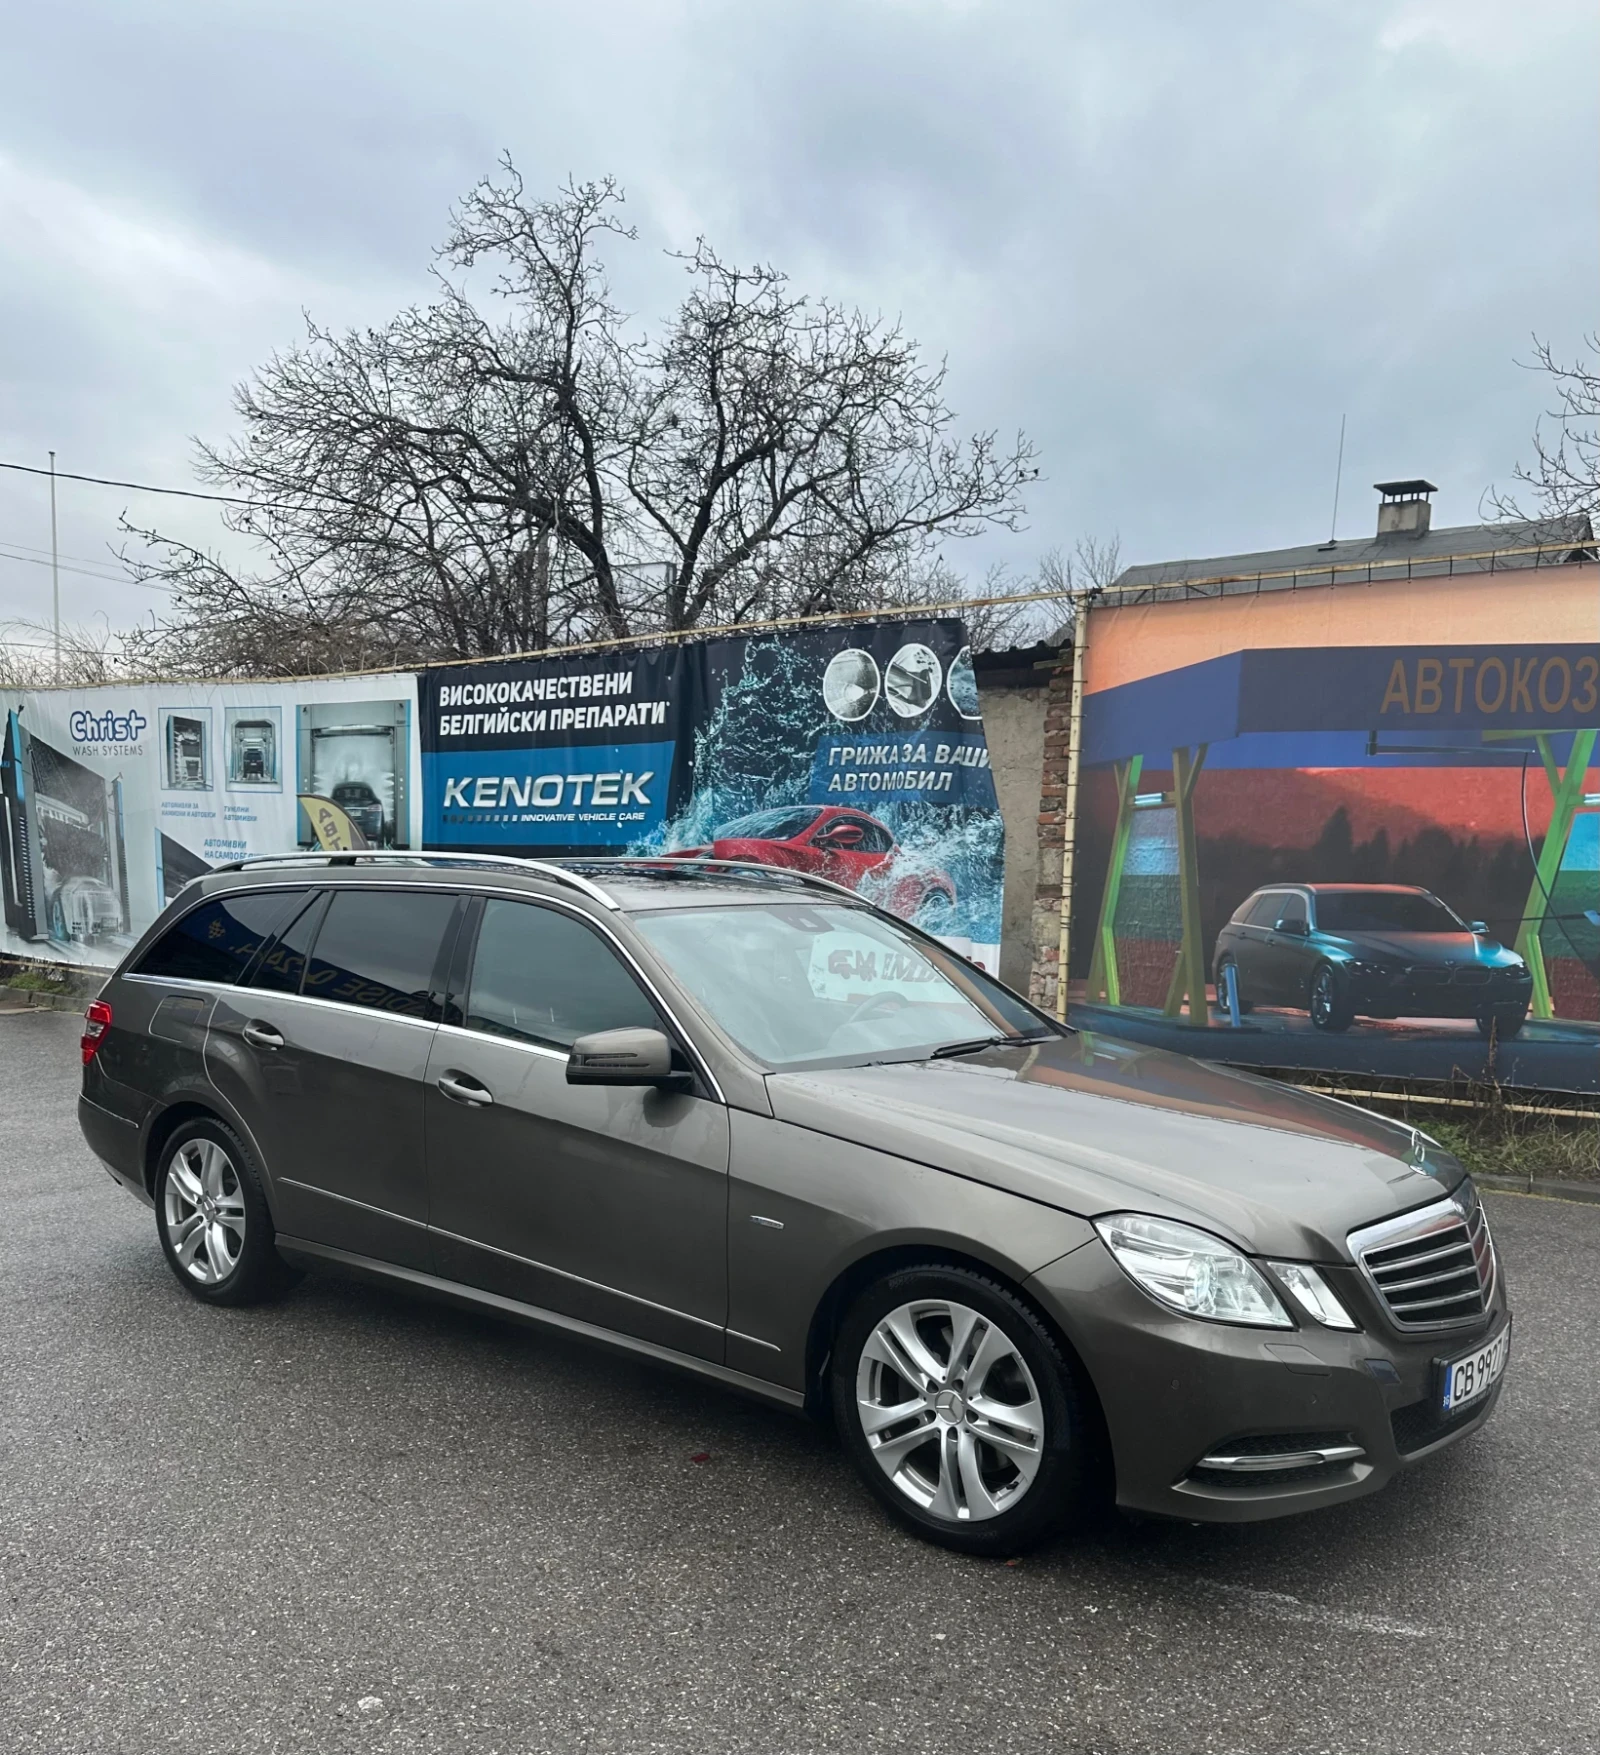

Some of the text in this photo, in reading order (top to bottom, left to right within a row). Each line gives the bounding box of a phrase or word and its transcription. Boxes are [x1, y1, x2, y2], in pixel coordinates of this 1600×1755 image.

[440, 671, 633, 706] ВИСОКОКАЧЕСТВЕНИ
[1380, 656, 1599, 713] АВТОКОЗ
[69, 709, 147, 742] Christ
[440, 707, 546, 736] БЕЛГИЙСКИ
[72, 744, 144, 756] WASH SYSTEMS
[443, 772, 654, 808] KENOTEK
[828, 771, 953, 792] АВТОМОБИЛ
[521, 812, 646, 822] INNOVATIVE VEHICLE CARE
[204, 839, 248, 849] АВТОМИВКИ
[1454, 1360, 1474, 1402] CB
